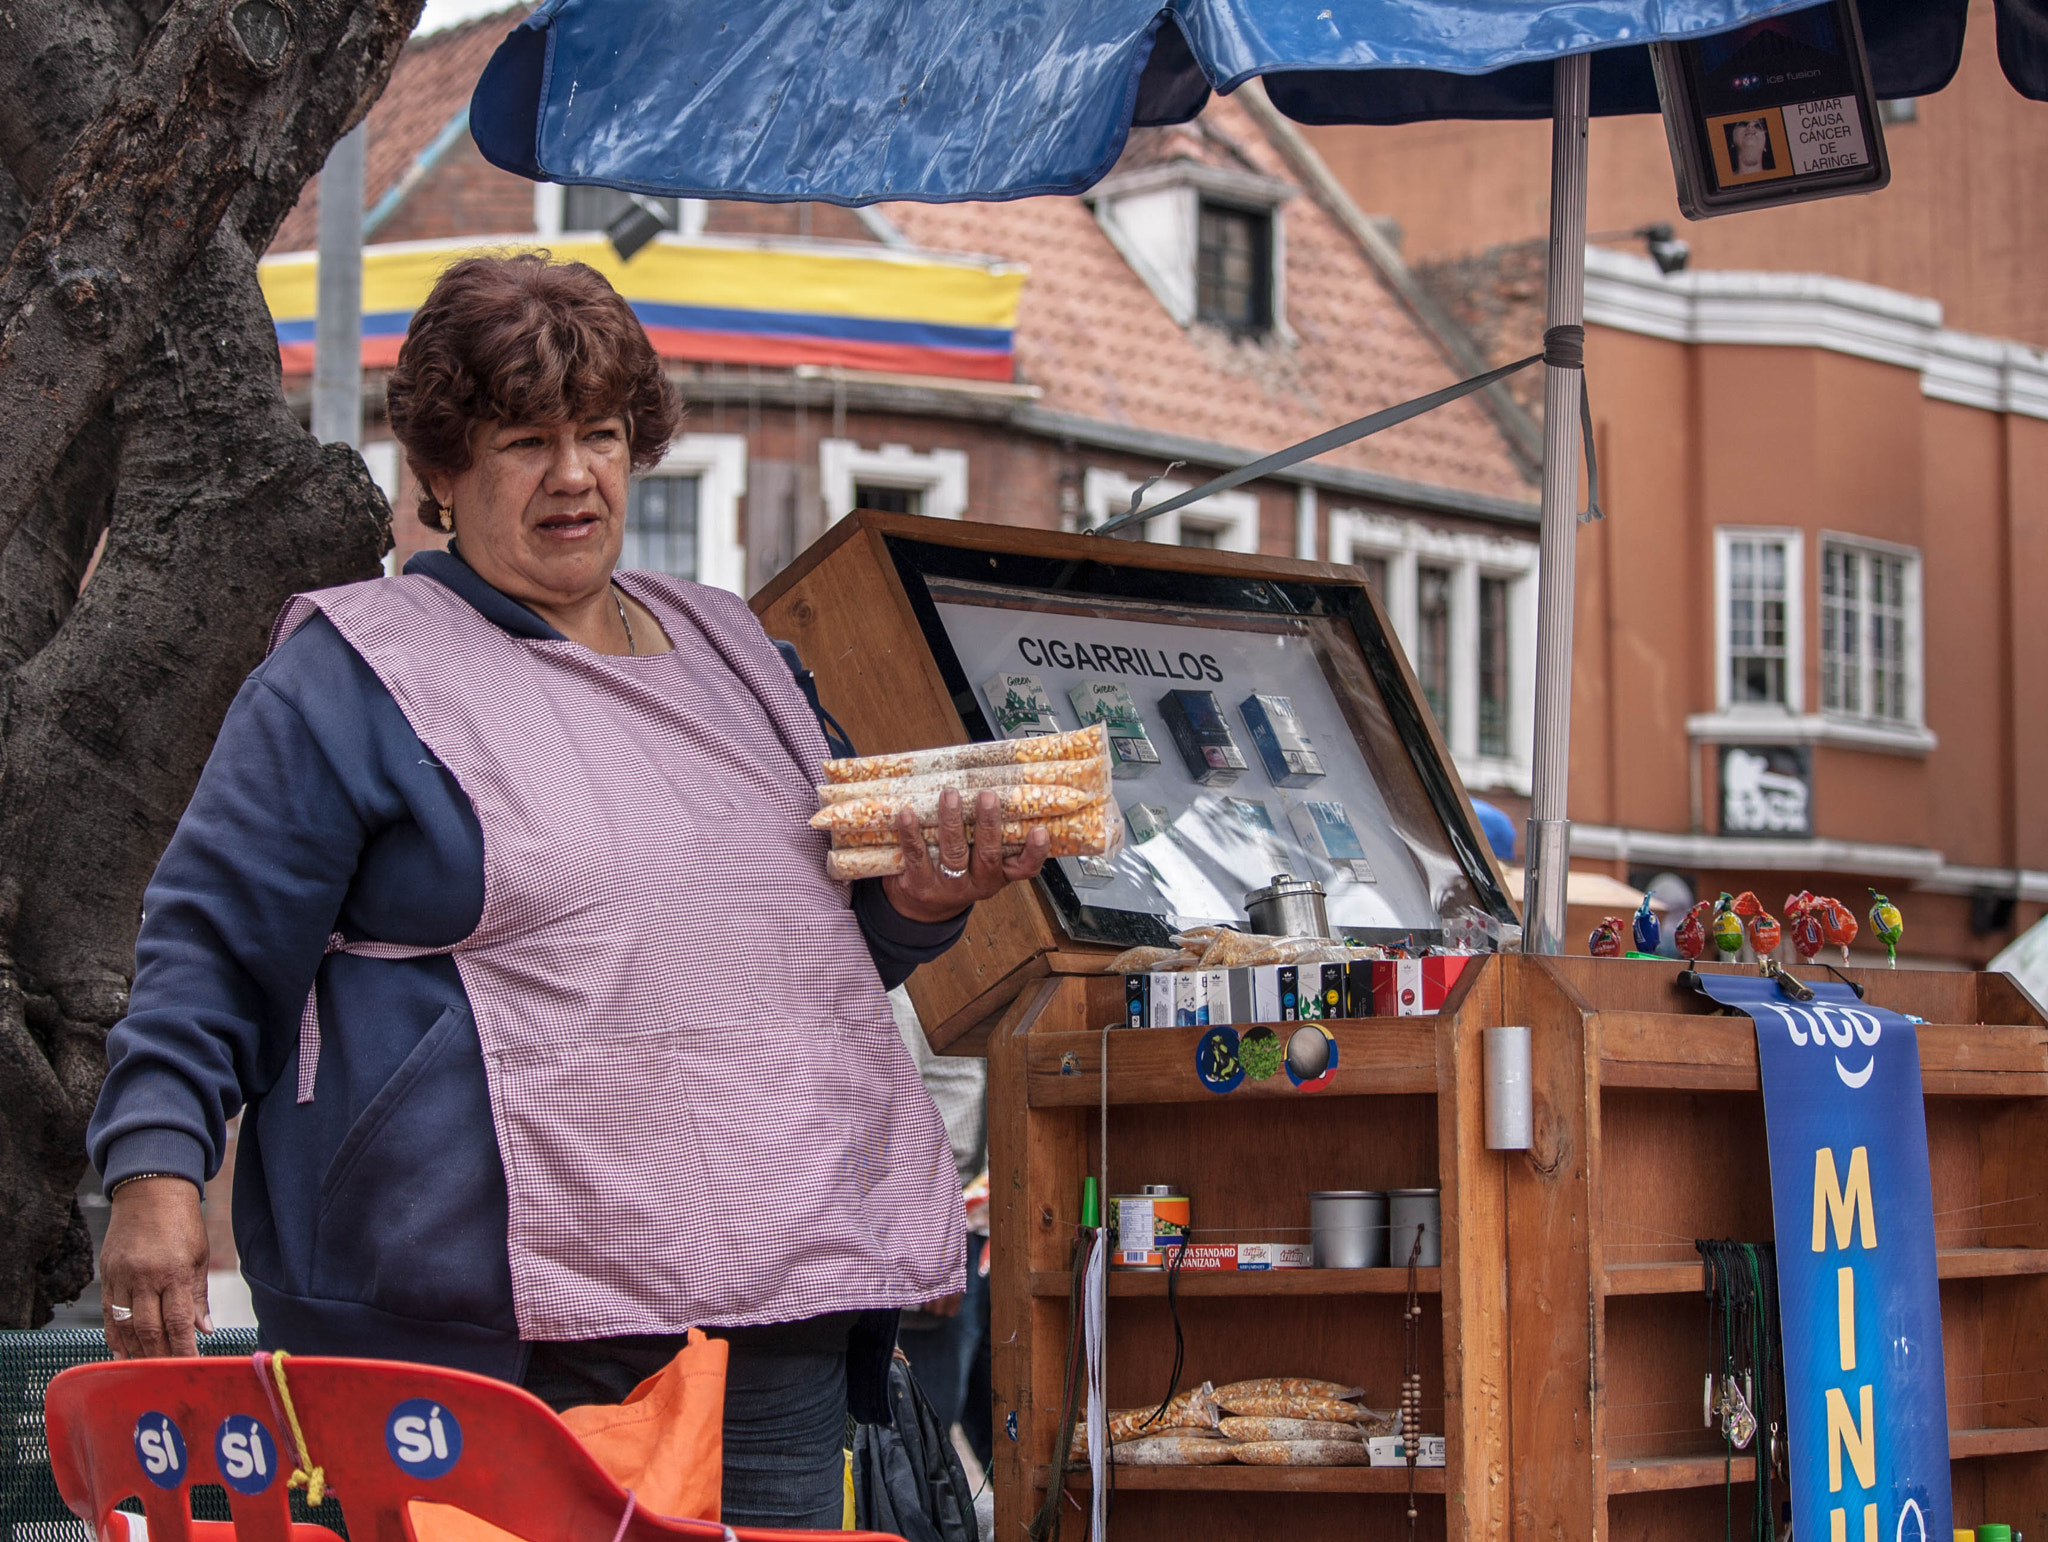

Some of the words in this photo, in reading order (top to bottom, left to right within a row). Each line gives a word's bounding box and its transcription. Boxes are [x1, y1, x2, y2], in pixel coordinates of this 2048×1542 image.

[1786, 69, 1821, 80] fusion
[1797, 98, 1843, 116] FUMAR
[1801, 113, 1845, 129] CAUSA
[1819, 142, 1838, 155] DE
[1803, 153, 1859, 172] LARINGE
[1018, 636, 1224, 683] CIGARRILLOS
[1195, 1247, 1236, 1258] STANDARD
